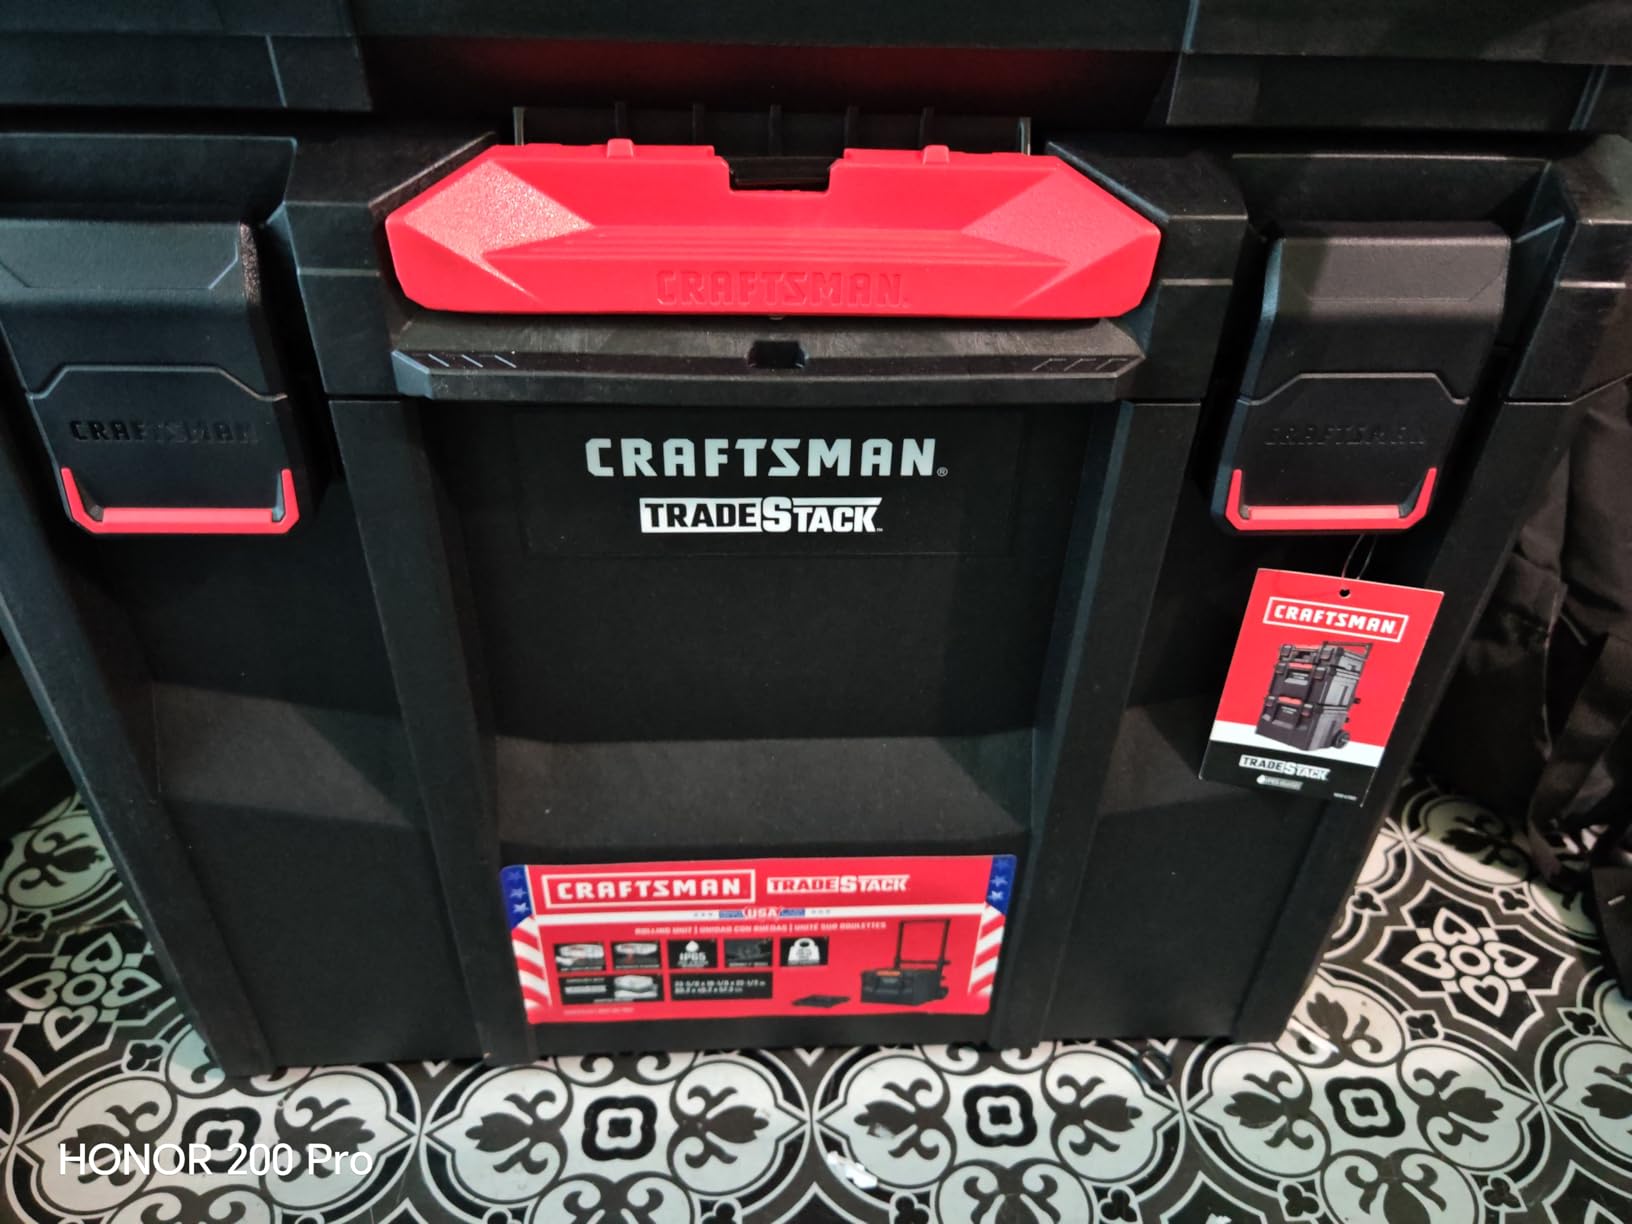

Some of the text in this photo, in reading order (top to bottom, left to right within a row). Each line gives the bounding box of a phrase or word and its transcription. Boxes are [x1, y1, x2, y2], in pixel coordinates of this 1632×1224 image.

[1273, 604, 1397, 635] CRAFTSMAN
[1239, 754, 1331, 781] TRADESTACK
[557, 875, 910, 899] CRAFTSMAN TRADESTACK
[747, 907, 778, 918] USA
